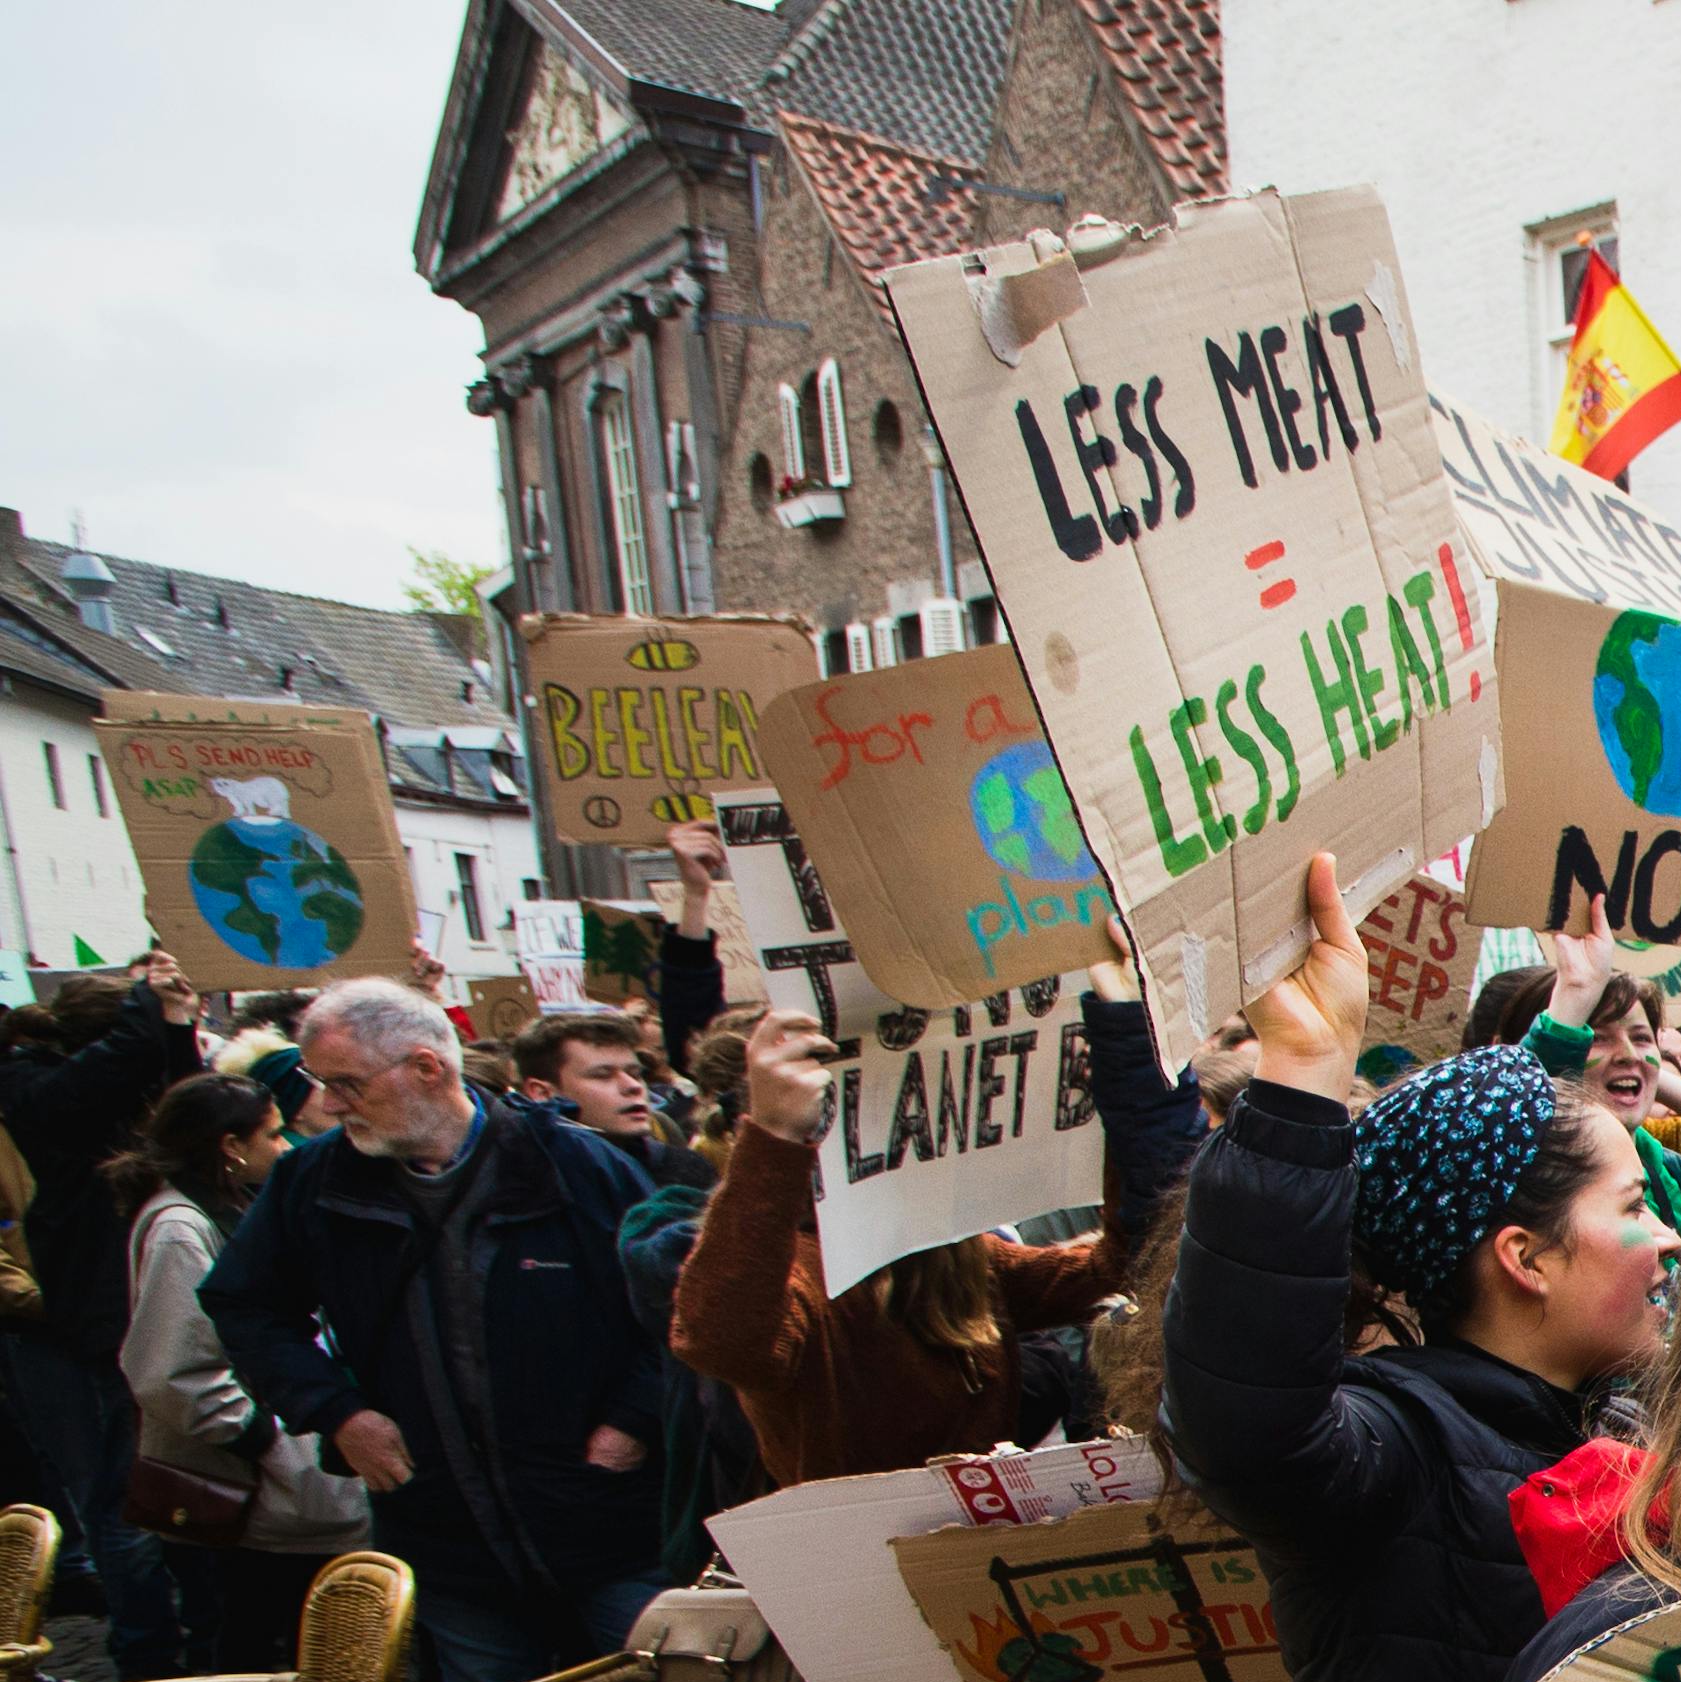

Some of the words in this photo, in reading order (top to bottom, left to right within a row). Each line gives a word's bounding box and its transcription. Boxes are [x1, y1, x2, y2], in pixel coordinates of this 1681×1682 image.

[1014, 374, 1196, 562] LESS
[1205, 303, 1386, 489] MEAT
[812, 686, 936, 791] for
[965, 692, 1037, 744] a
[1130, 663, 1301, 878] LESS
[1300, 542, 1484, 780] HEAT!
[195, 745, 261, 767] SEND
[265, 750, 315, 769] HELP
[1364, 879, 1466, 962] ET'S
[1360, 931, 1450, 1022] EEP
[1023, 1562, 1186, 1609] WHERE
[1210, 1557, 1256, 1585] IS
